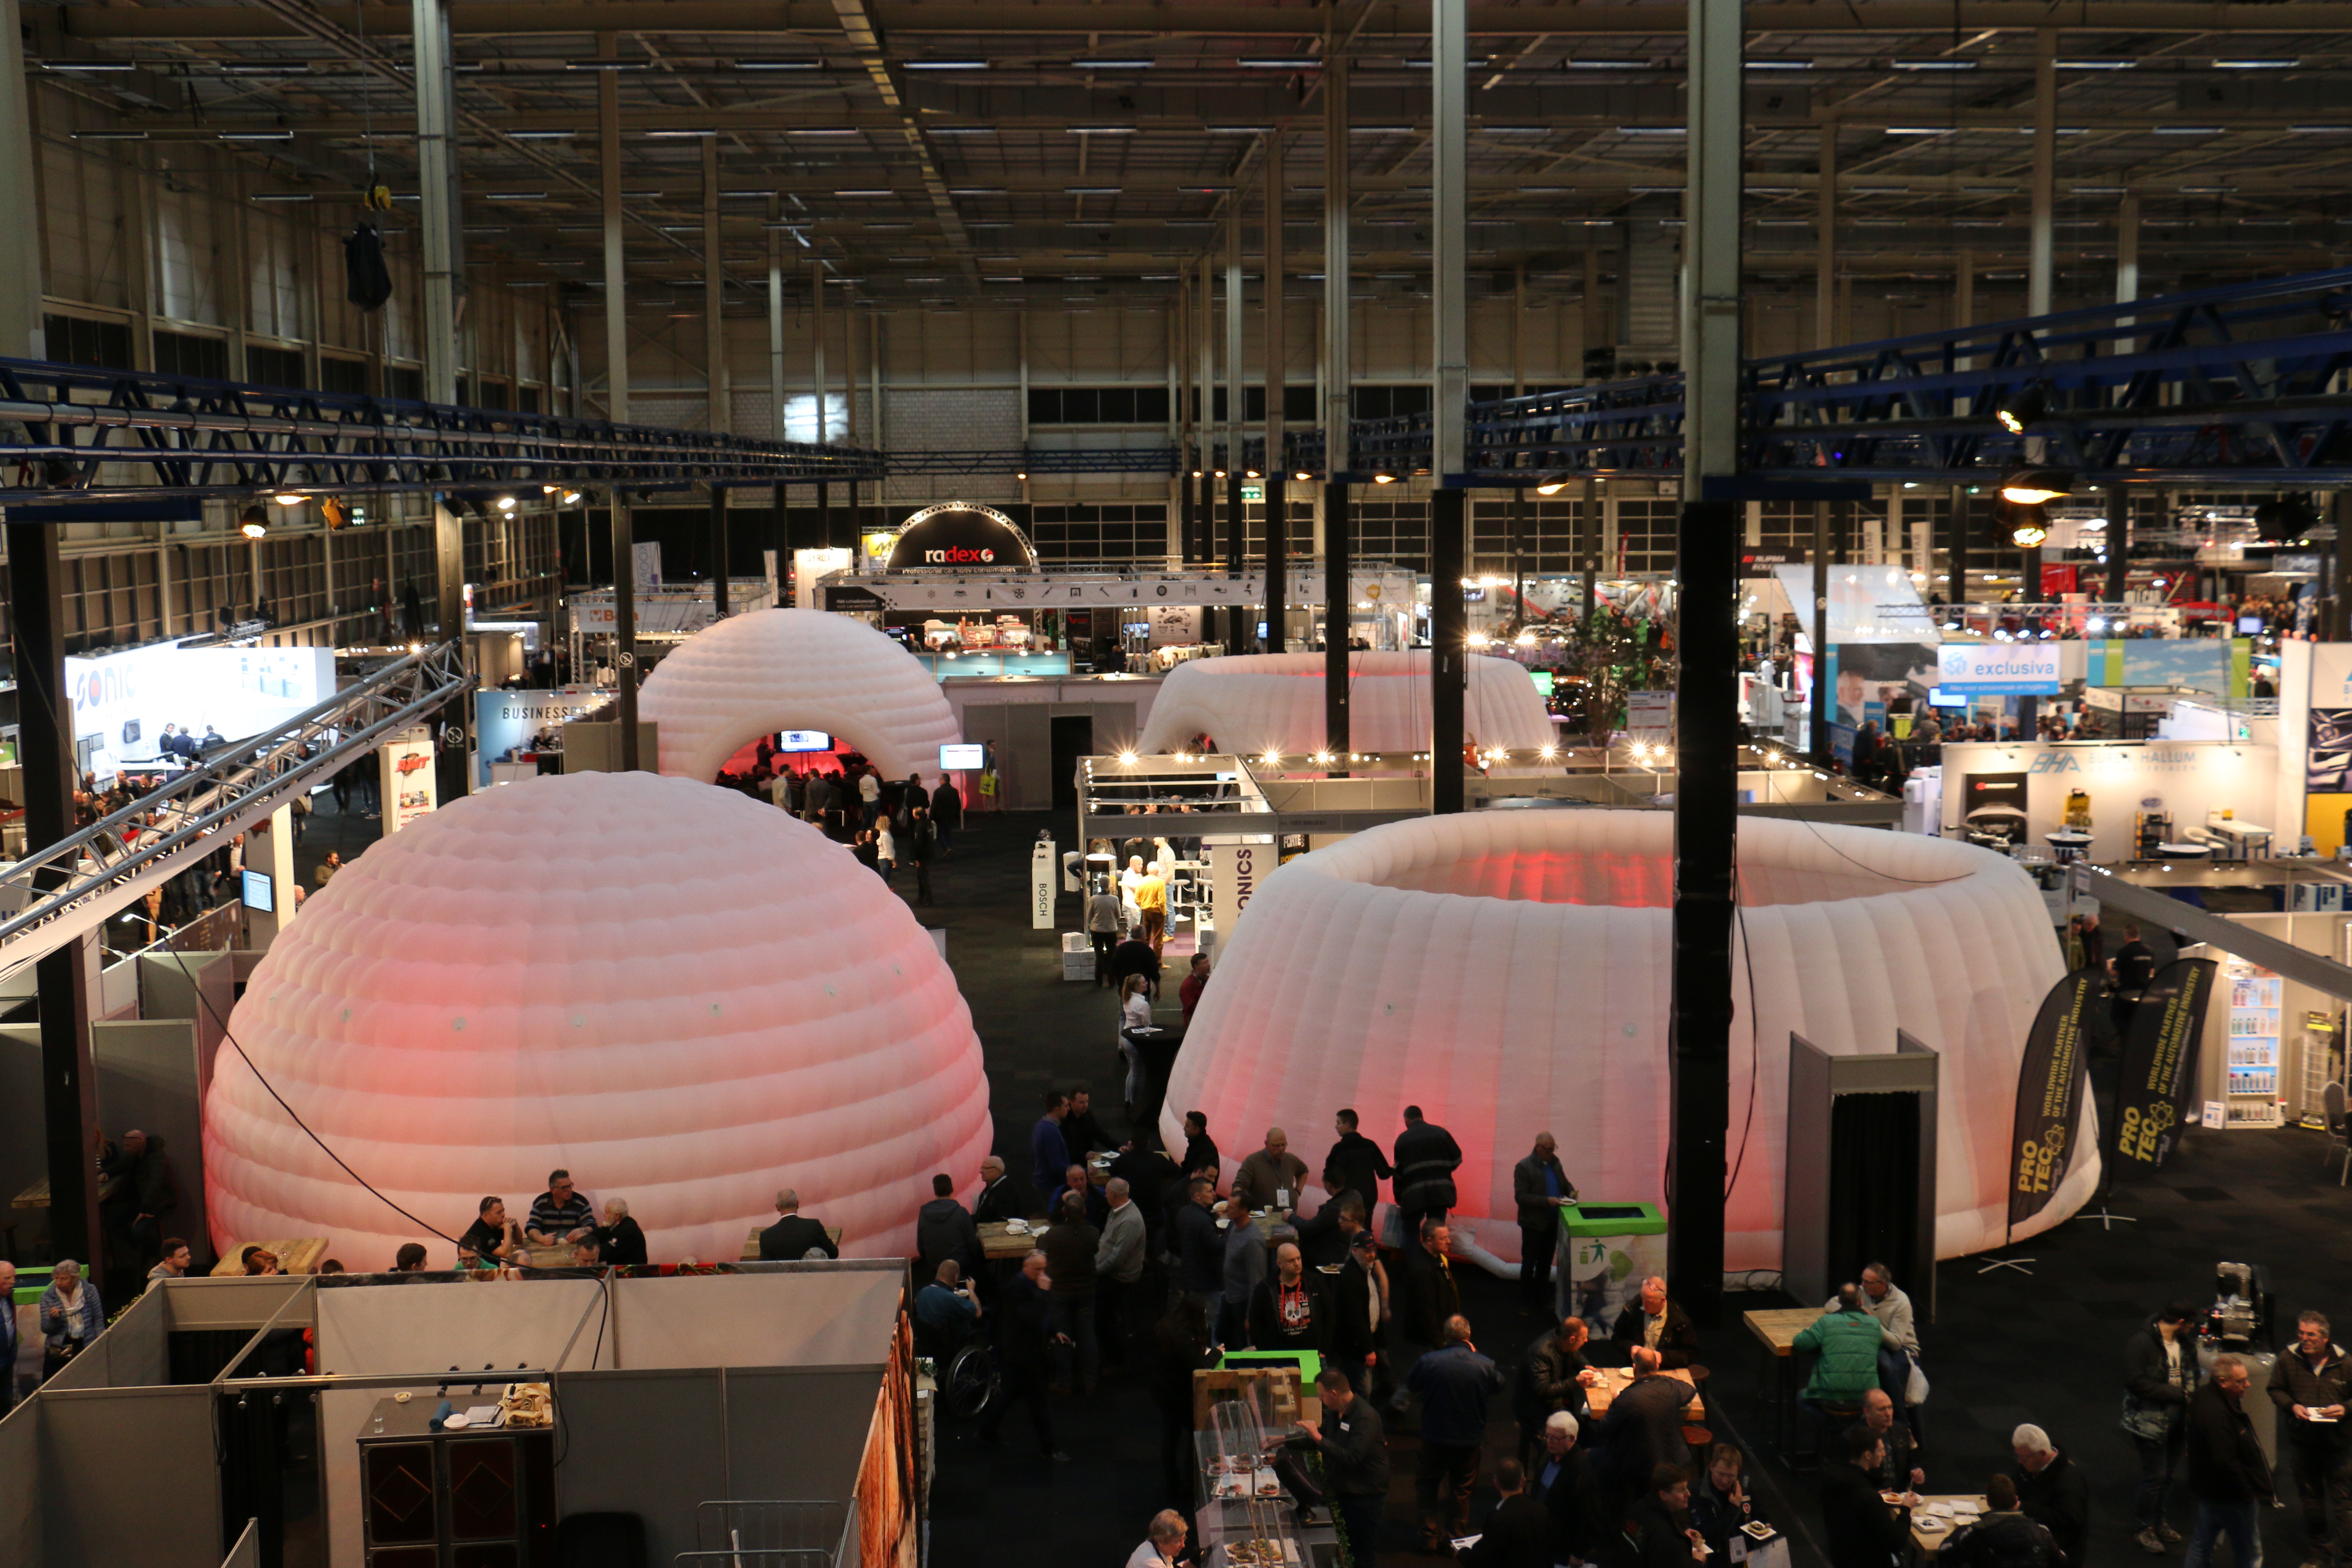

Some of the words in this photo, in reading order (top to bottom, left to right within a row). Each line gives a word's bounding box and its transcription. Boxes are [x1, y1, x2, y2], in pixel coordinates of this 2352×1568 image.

[925, 545, 981, 563] radex
[603, 609, 639, 622] Ba
[77, 663, 136, 711] SONIC
[1975, 661, 2055, 675] exclusiva
[395, 756, 430, 772] AMT
[2028, 753, 2081, 773] BHA
[2141, 752, 2196, 763] HALLUM
[1283, 834, 1302, 848] FORTE
[1039, 883, 1047, 916] BOSCH
[1237, 849, 1252, 918] ONICS
[2070, 977, 2088, 1024] INDUSTRY
[2179, 966, 2201, 1010] INDUSTRY
[2058, 1026, 2077, 1084] AUTOMOTIVE
[2147, 1036, 2168, 1090] WORLDWIDE
[2160, 997, 2179, 1037] PARTNER
[2165, 1010, 2188, 1065] AUTOMOTIVE
[2043, 1059, 2061, 1117] WORLDWIDE
[2054, 1015, 2070, 1057] PARTNER
[2161, 1065, 2172, 1082] THE
[2054, 1084, 2064, 1104] THE
[2158, 1082, 2168, 1094] OF
[2052, 1106, 2061, 1118] OF
[2119, 1106, 2141, 1156] PRO
[2135, 1118, 2159, 1162] TEC
[2018, 1140, 2038, 1192] PRO
[2034, 1147, 2053, 1194] TEC
